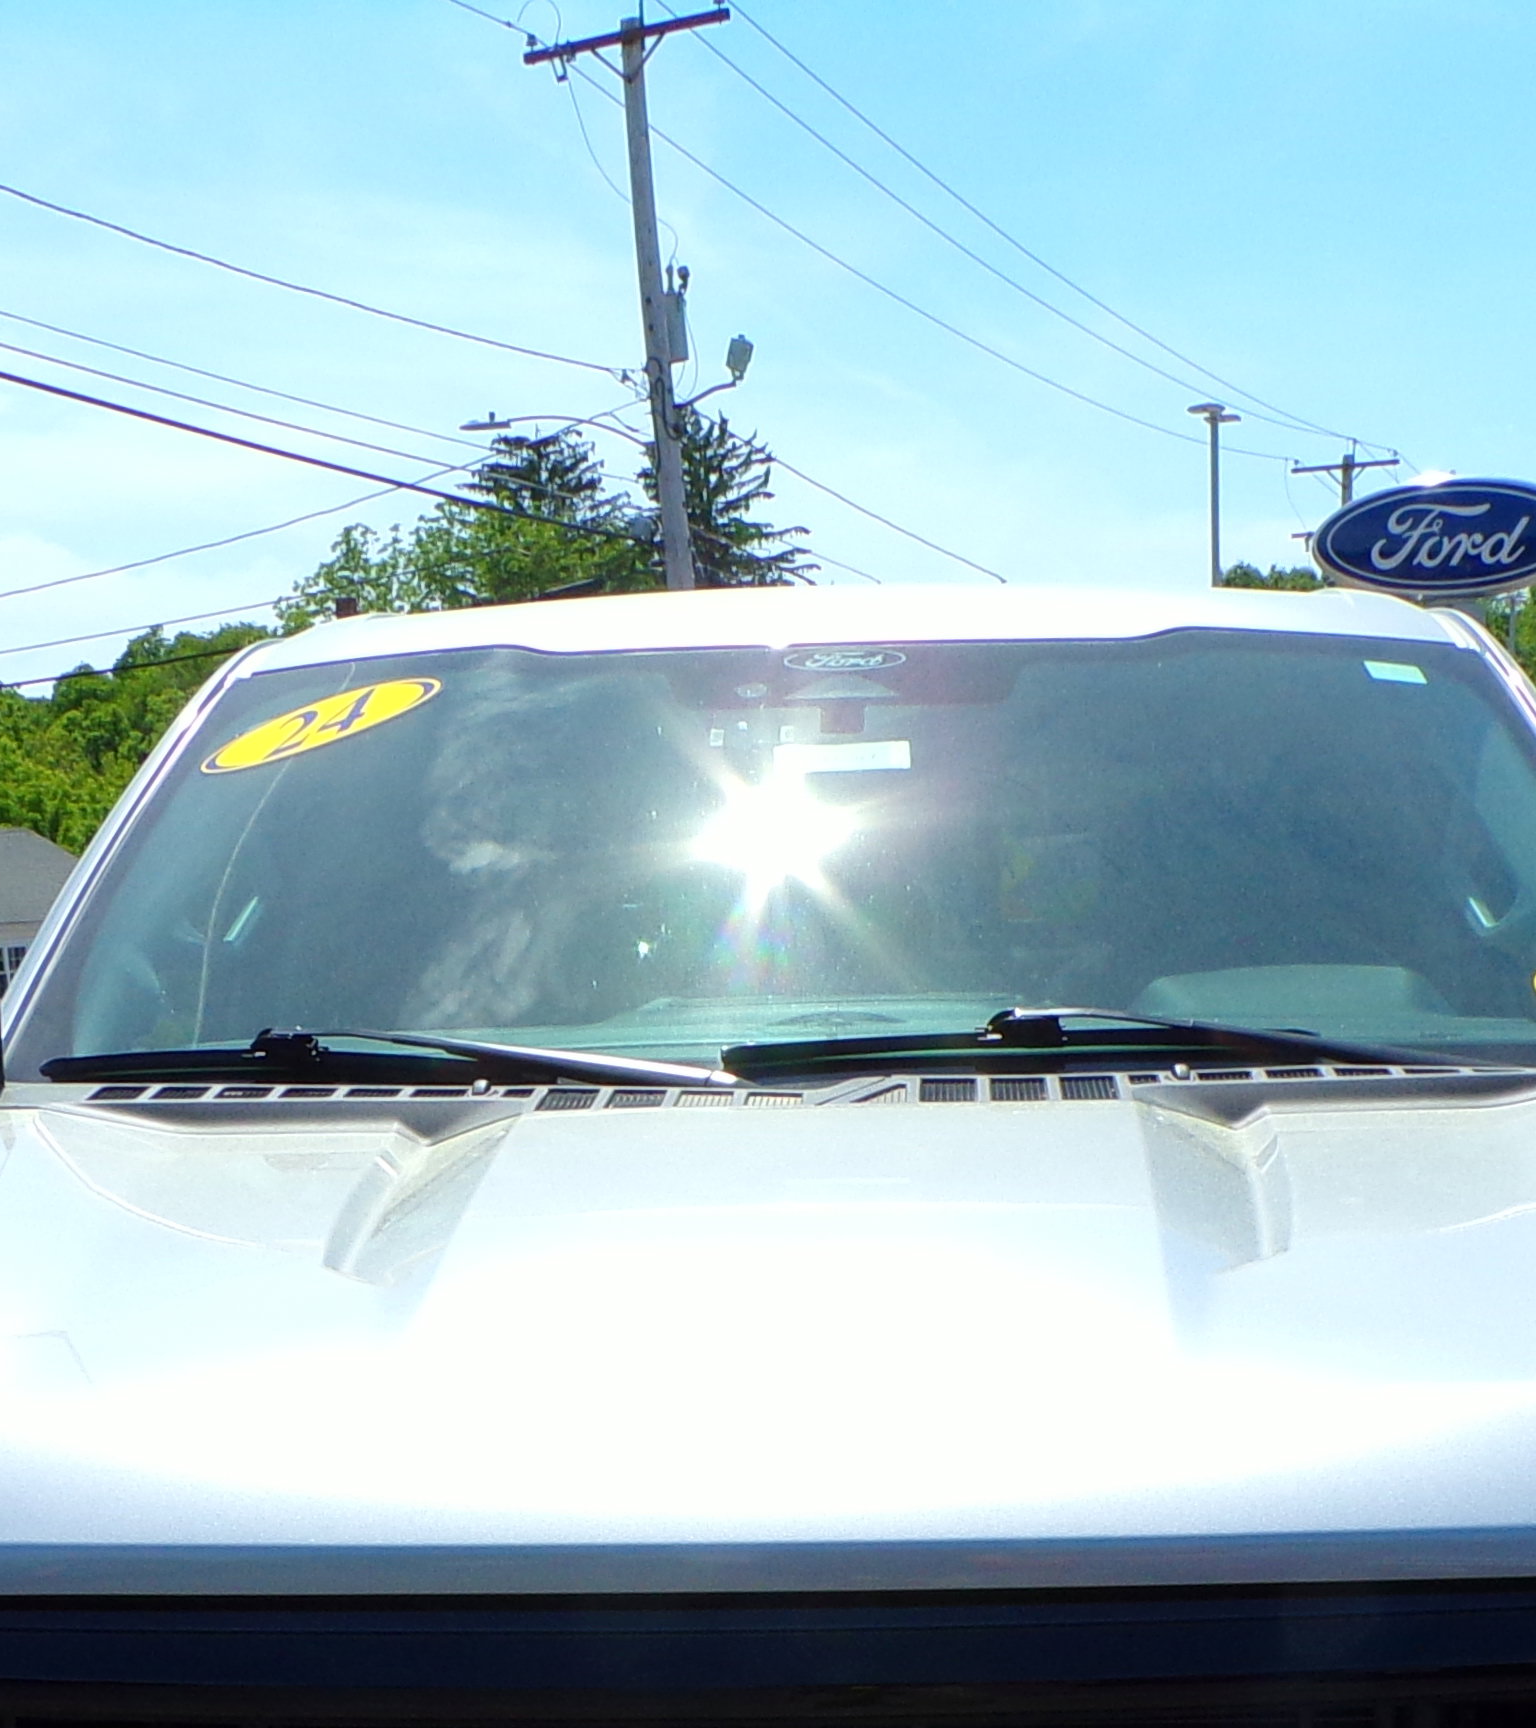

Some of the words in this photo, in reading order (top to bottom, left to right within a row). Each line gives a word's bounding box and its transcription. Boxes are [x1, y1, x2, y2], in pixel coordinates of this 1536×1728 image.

[1370, 503, 1529, 570] Ford
[805, 652, 883, 668] Ford
[262, 688, 376, 759] 24
